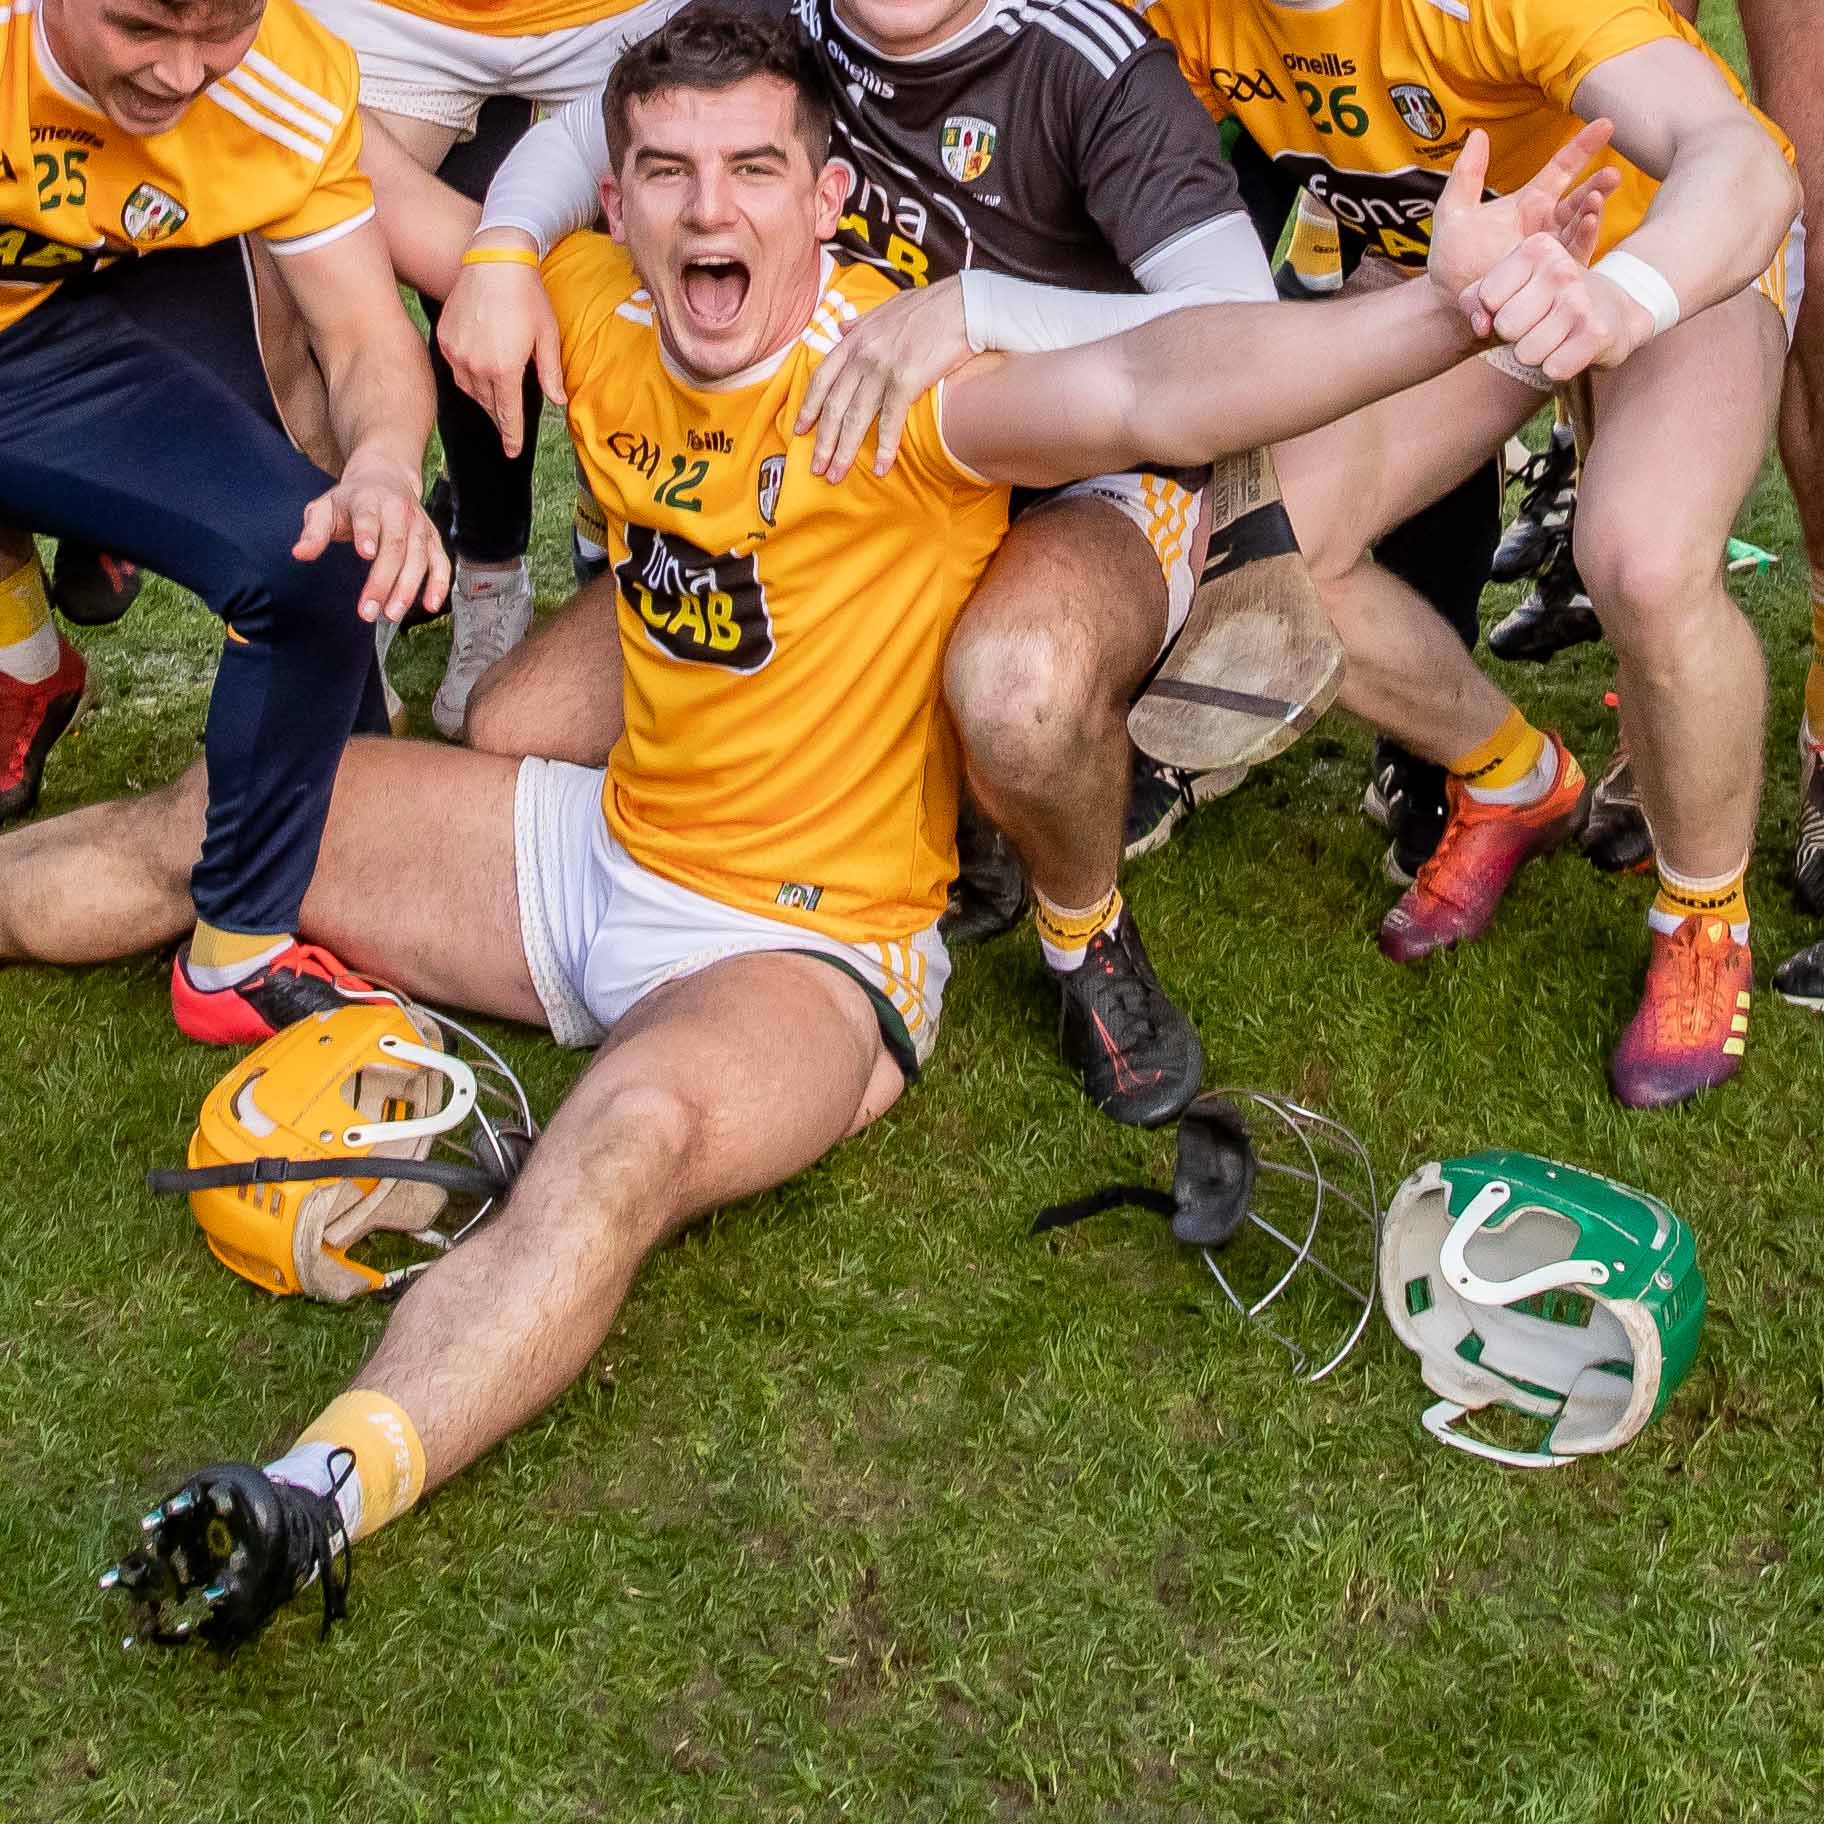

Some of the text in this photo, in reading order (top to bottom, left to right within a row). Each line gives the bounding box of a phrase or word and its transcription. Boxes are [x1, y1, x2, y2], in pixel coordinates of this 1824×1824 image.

[1295, 81, 1370, 137] 26
[33, 149, 90, 212] 25
[653, 454, 711, 514] 12
[633, 581, 742, 652] CAB
